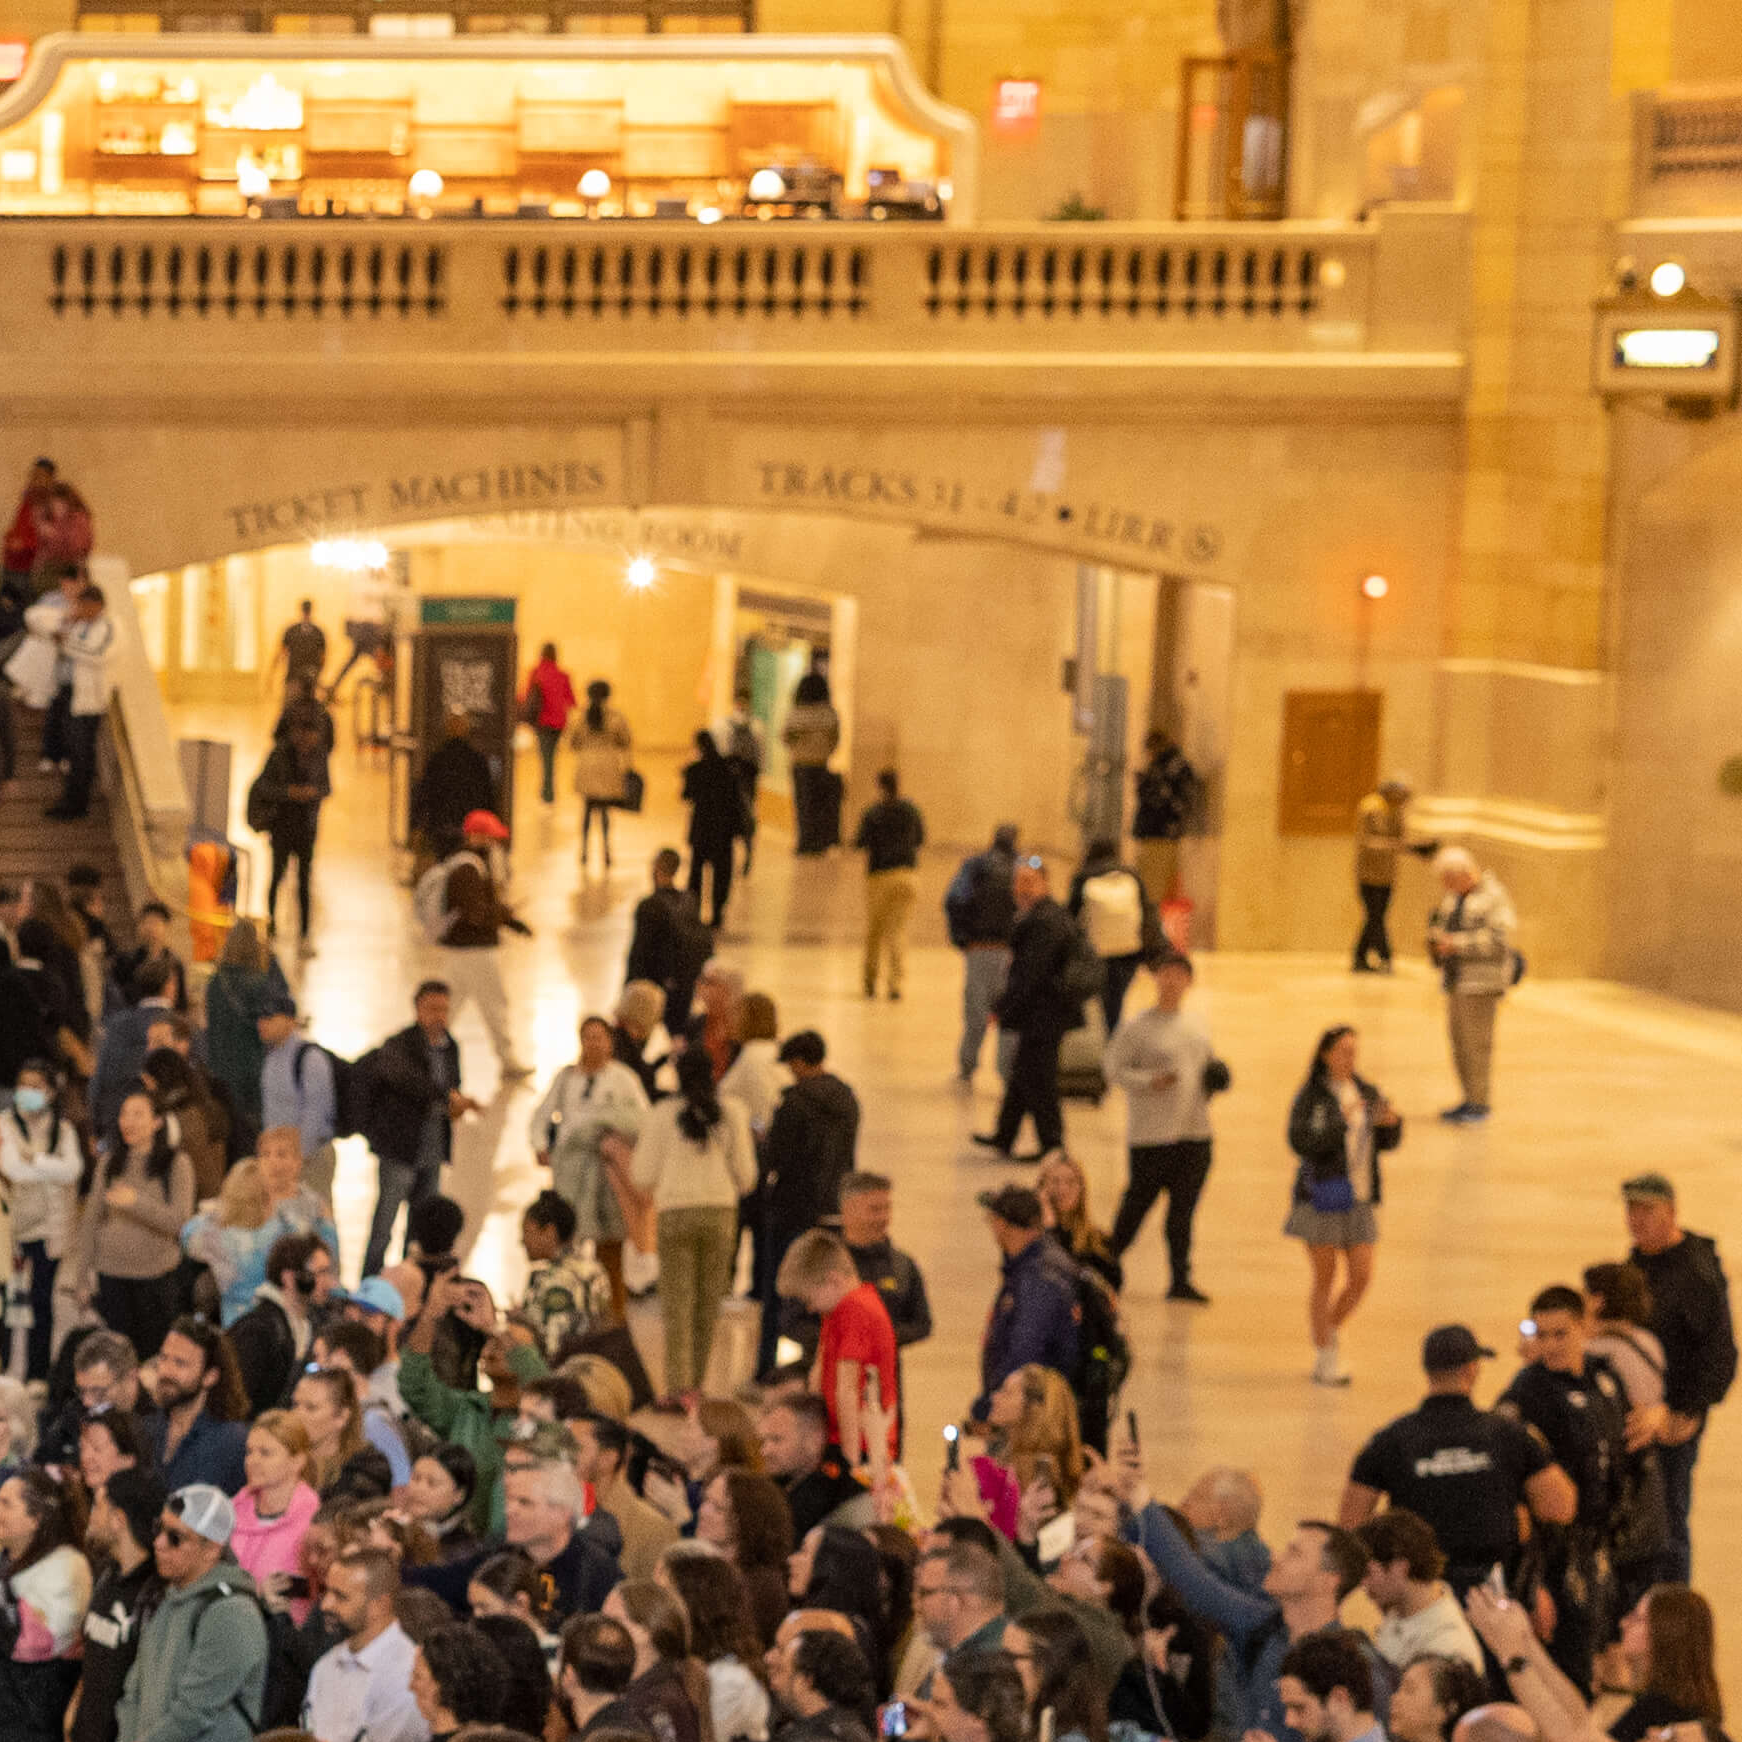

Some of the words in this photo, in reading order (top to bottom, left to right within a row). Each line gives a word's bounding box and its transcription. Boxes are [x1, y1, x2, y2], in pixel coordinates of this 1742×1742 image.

[227, 481, 370, 538] TICKET
[388, 460, 606, 511] MACHINES
[756, 461, 917, 500] TRACKS
